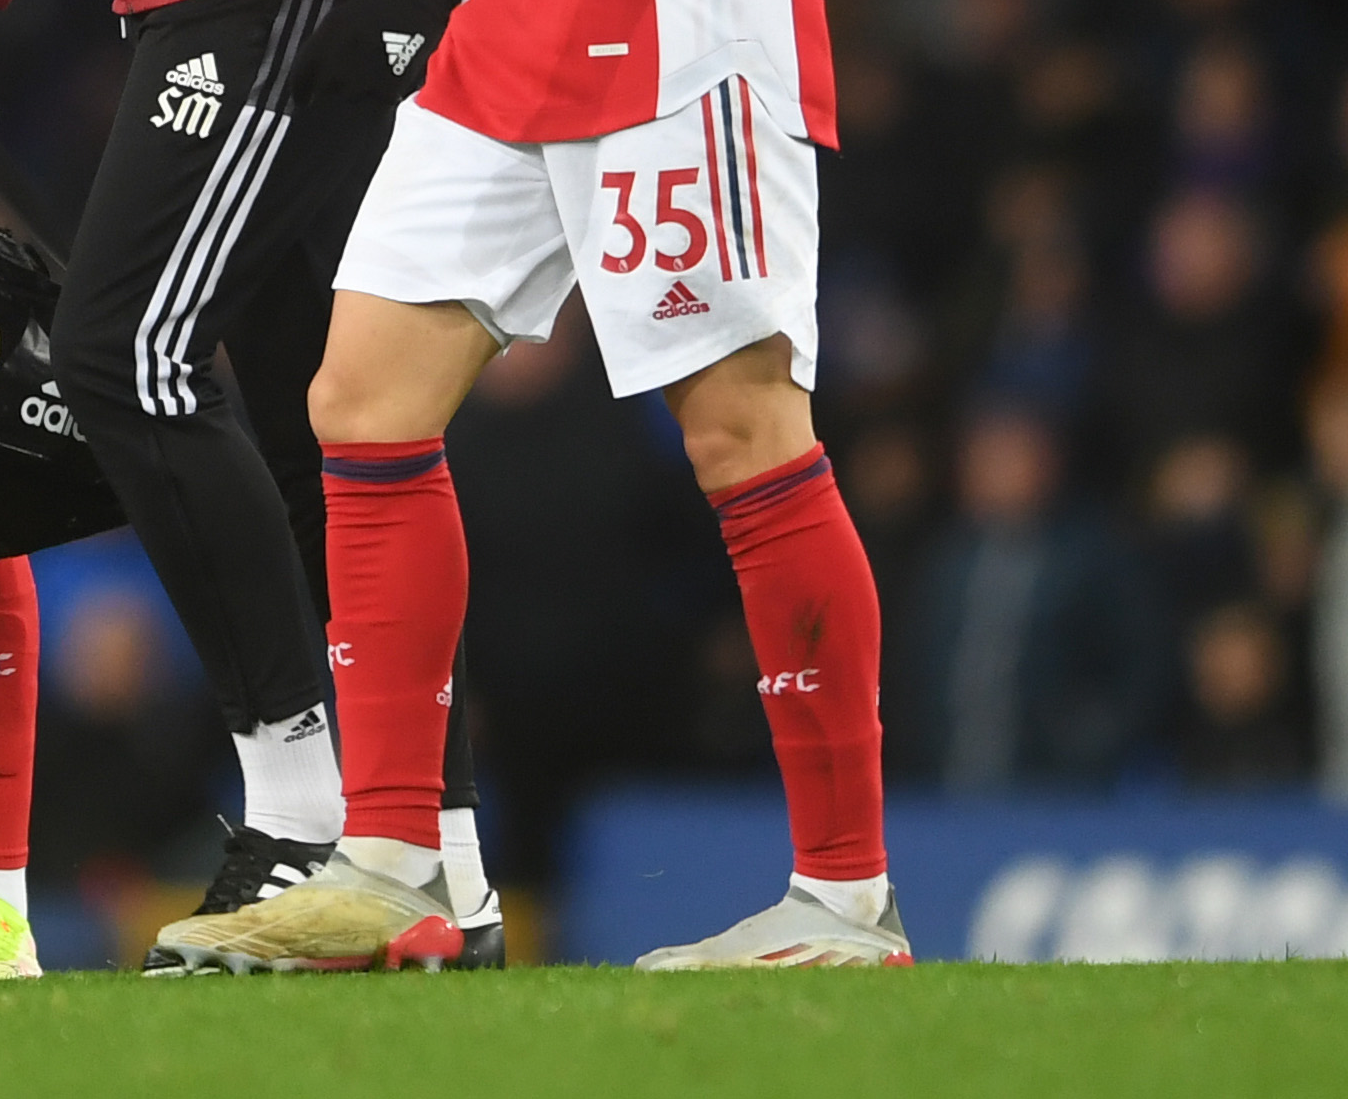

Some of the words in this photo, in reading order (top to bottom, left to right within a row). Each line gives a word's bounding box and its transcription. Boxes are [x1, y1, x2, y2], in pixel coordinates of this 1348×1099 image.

[392, 32, 426, 76] adidas
[165, 69, 225, 96] adidas
[600, 167, 709, 275] 35
[652, 302, 711, 321] adidas
[756, 668, 821, 696] AFC
